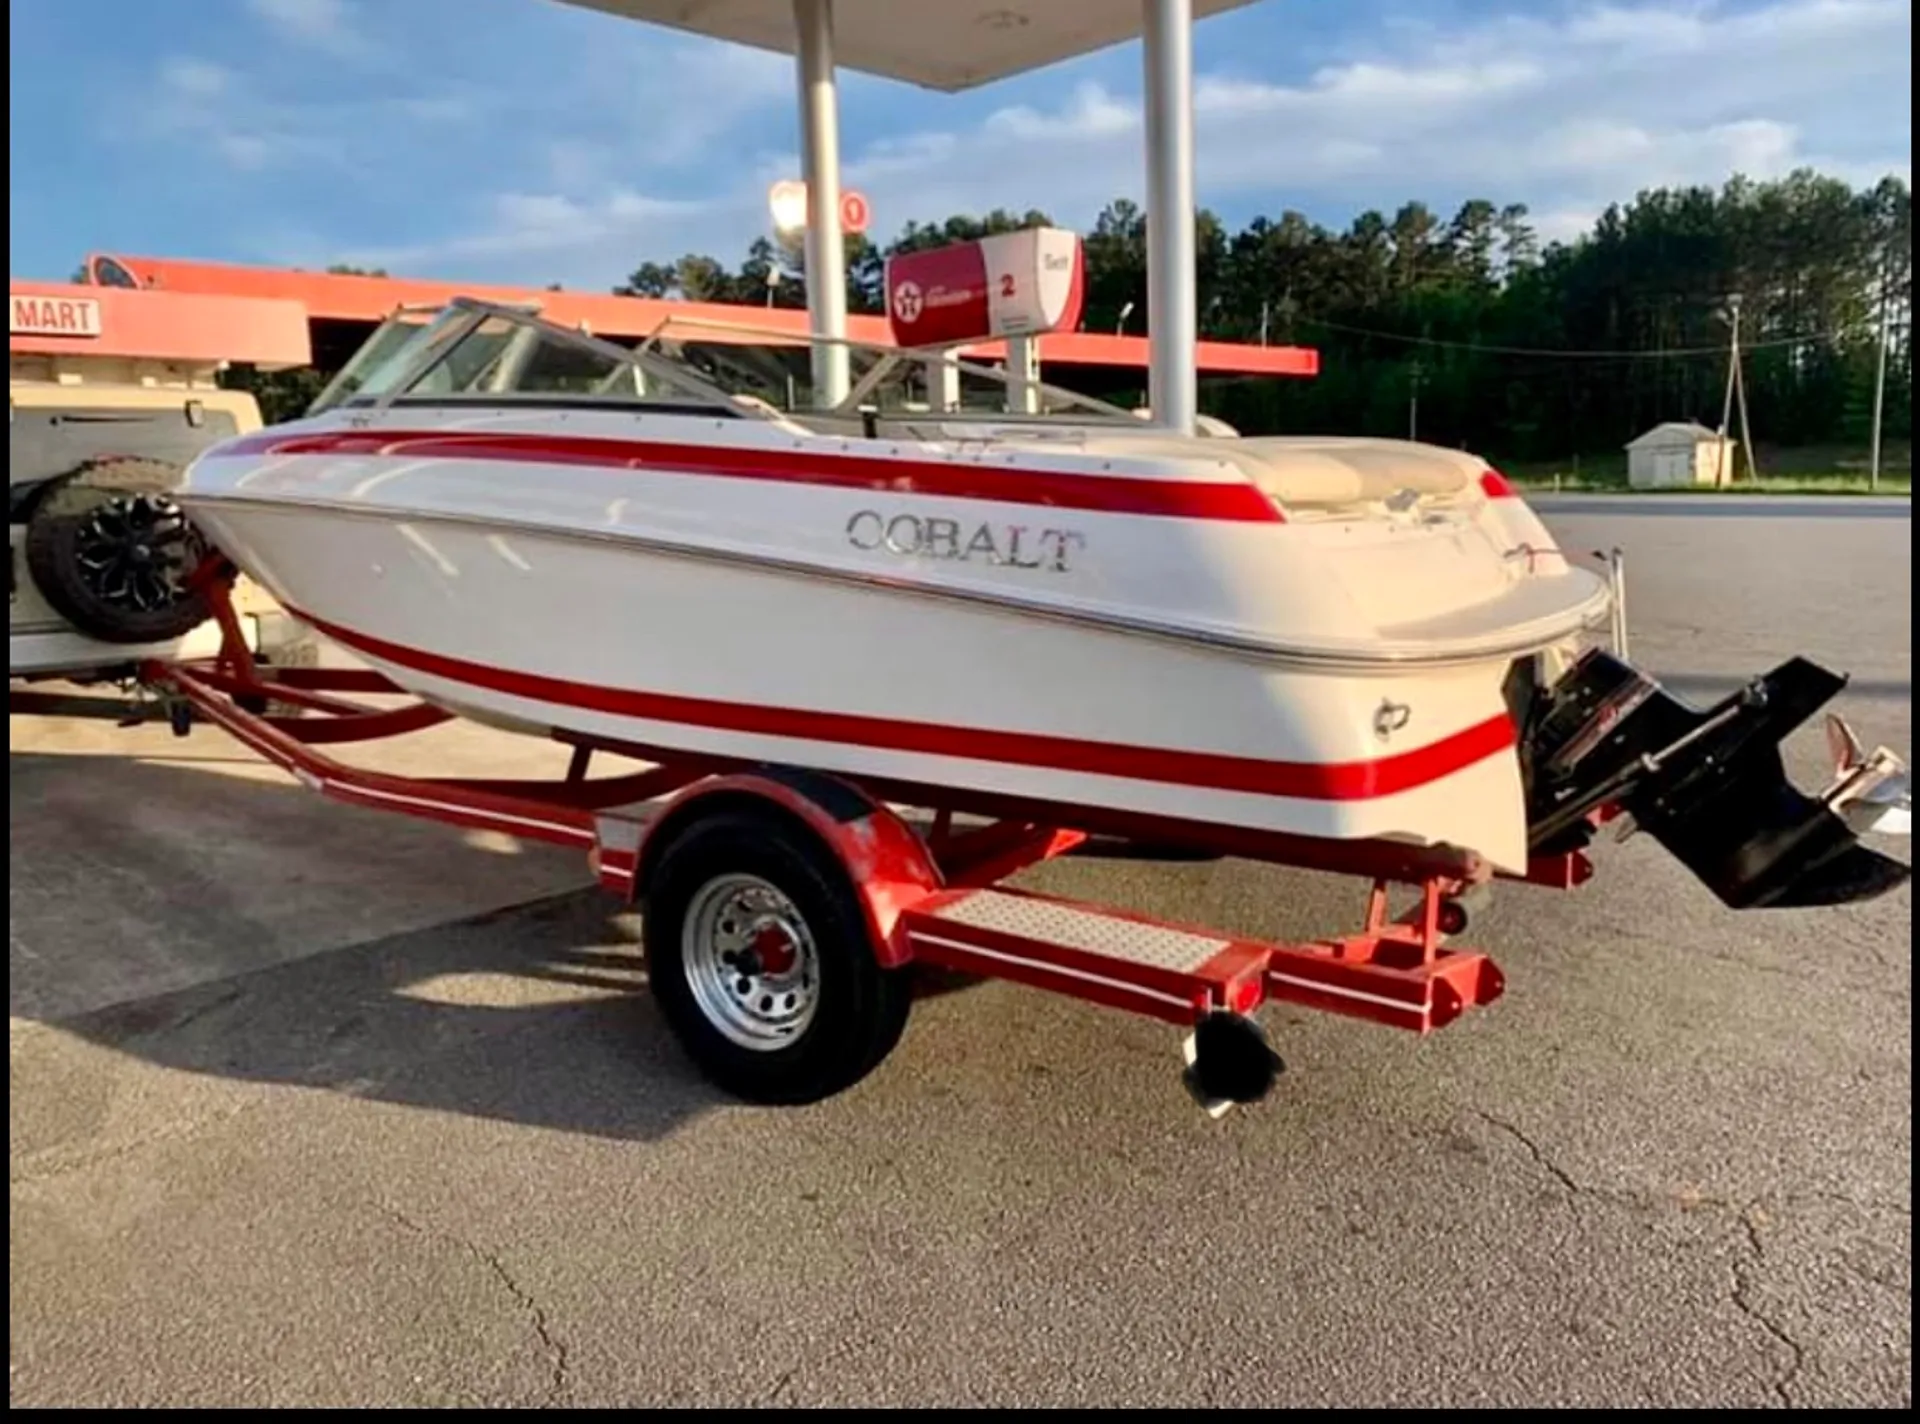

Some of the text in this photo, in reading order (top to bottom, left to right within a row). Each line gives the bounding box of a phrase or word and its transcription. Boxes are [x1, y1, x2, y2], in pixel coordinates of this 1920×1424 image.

[1001, 273, 1016, 297] 2
[15, 299, 91, 331] MART
[845, 508, 1086, 573] COBALT
